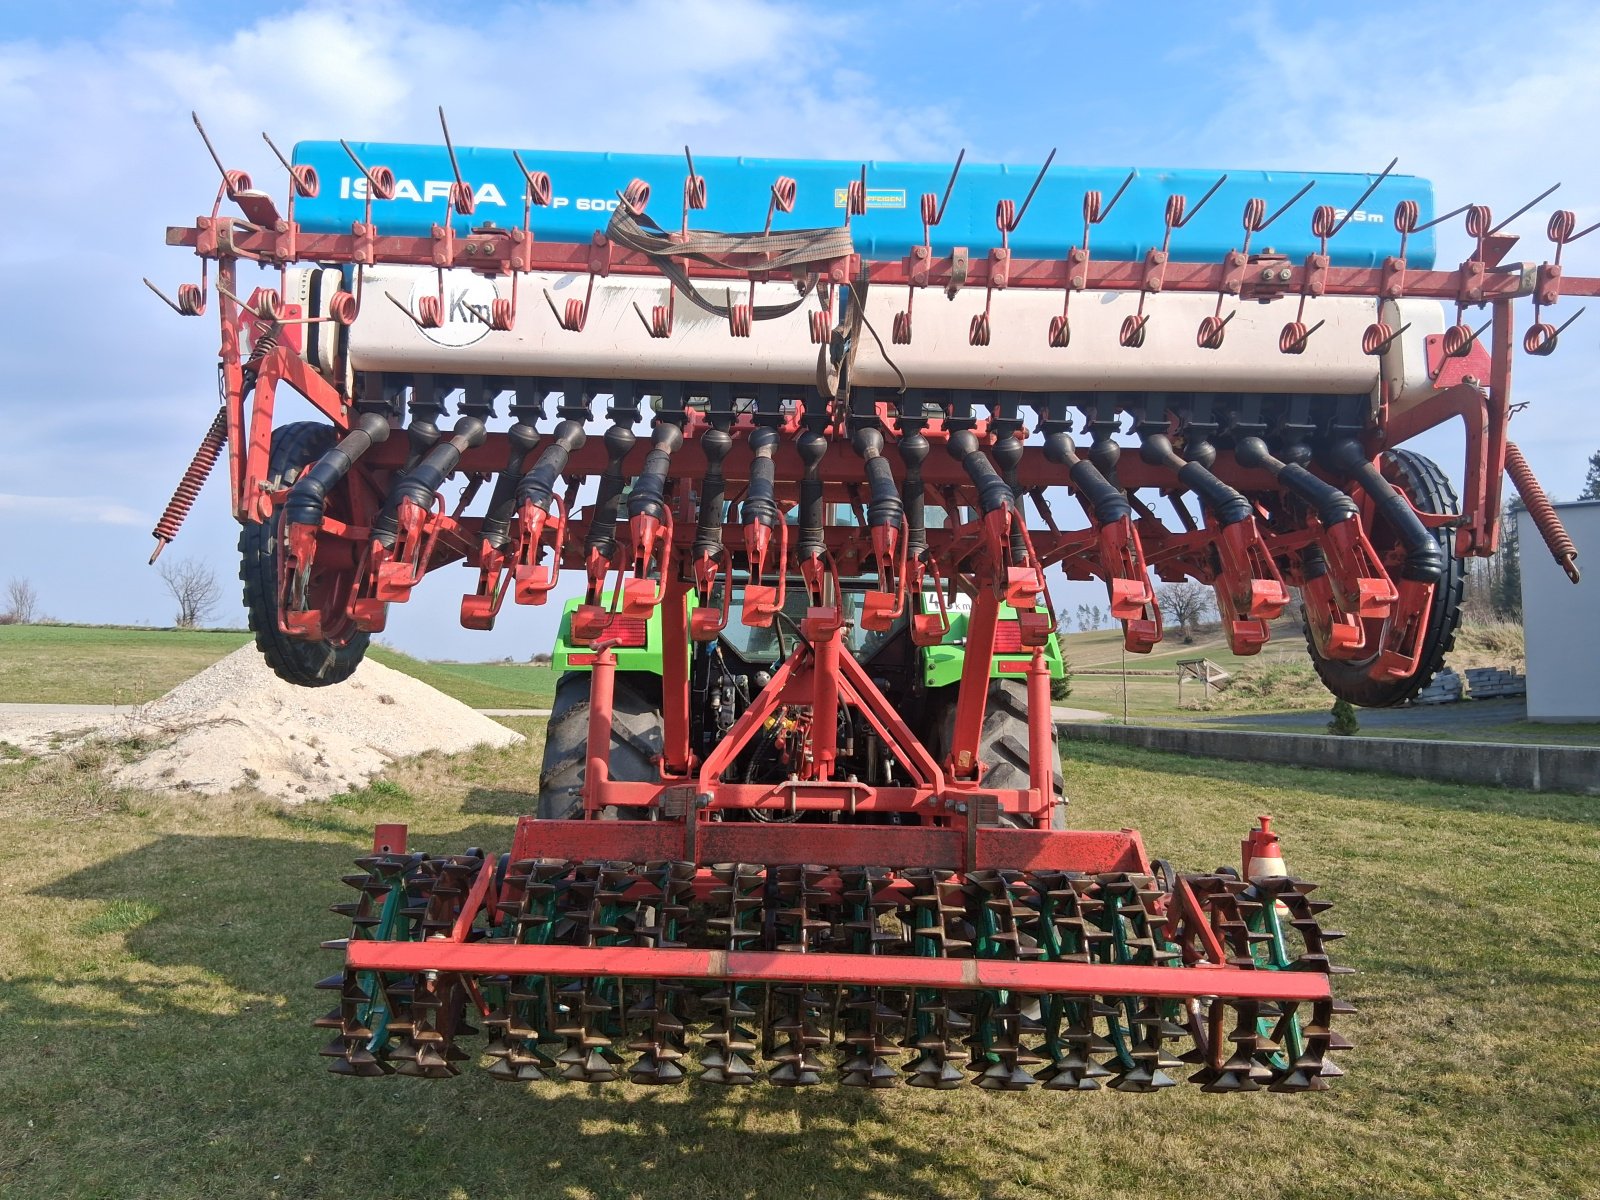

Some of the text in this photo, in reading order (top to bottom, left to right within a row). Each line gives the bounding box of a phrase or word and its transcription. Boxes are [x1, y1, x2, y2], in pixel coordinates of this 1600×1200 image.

[340, 177, 632, 211] ISARA TP 600
[450, 288, 490, 323] Km
